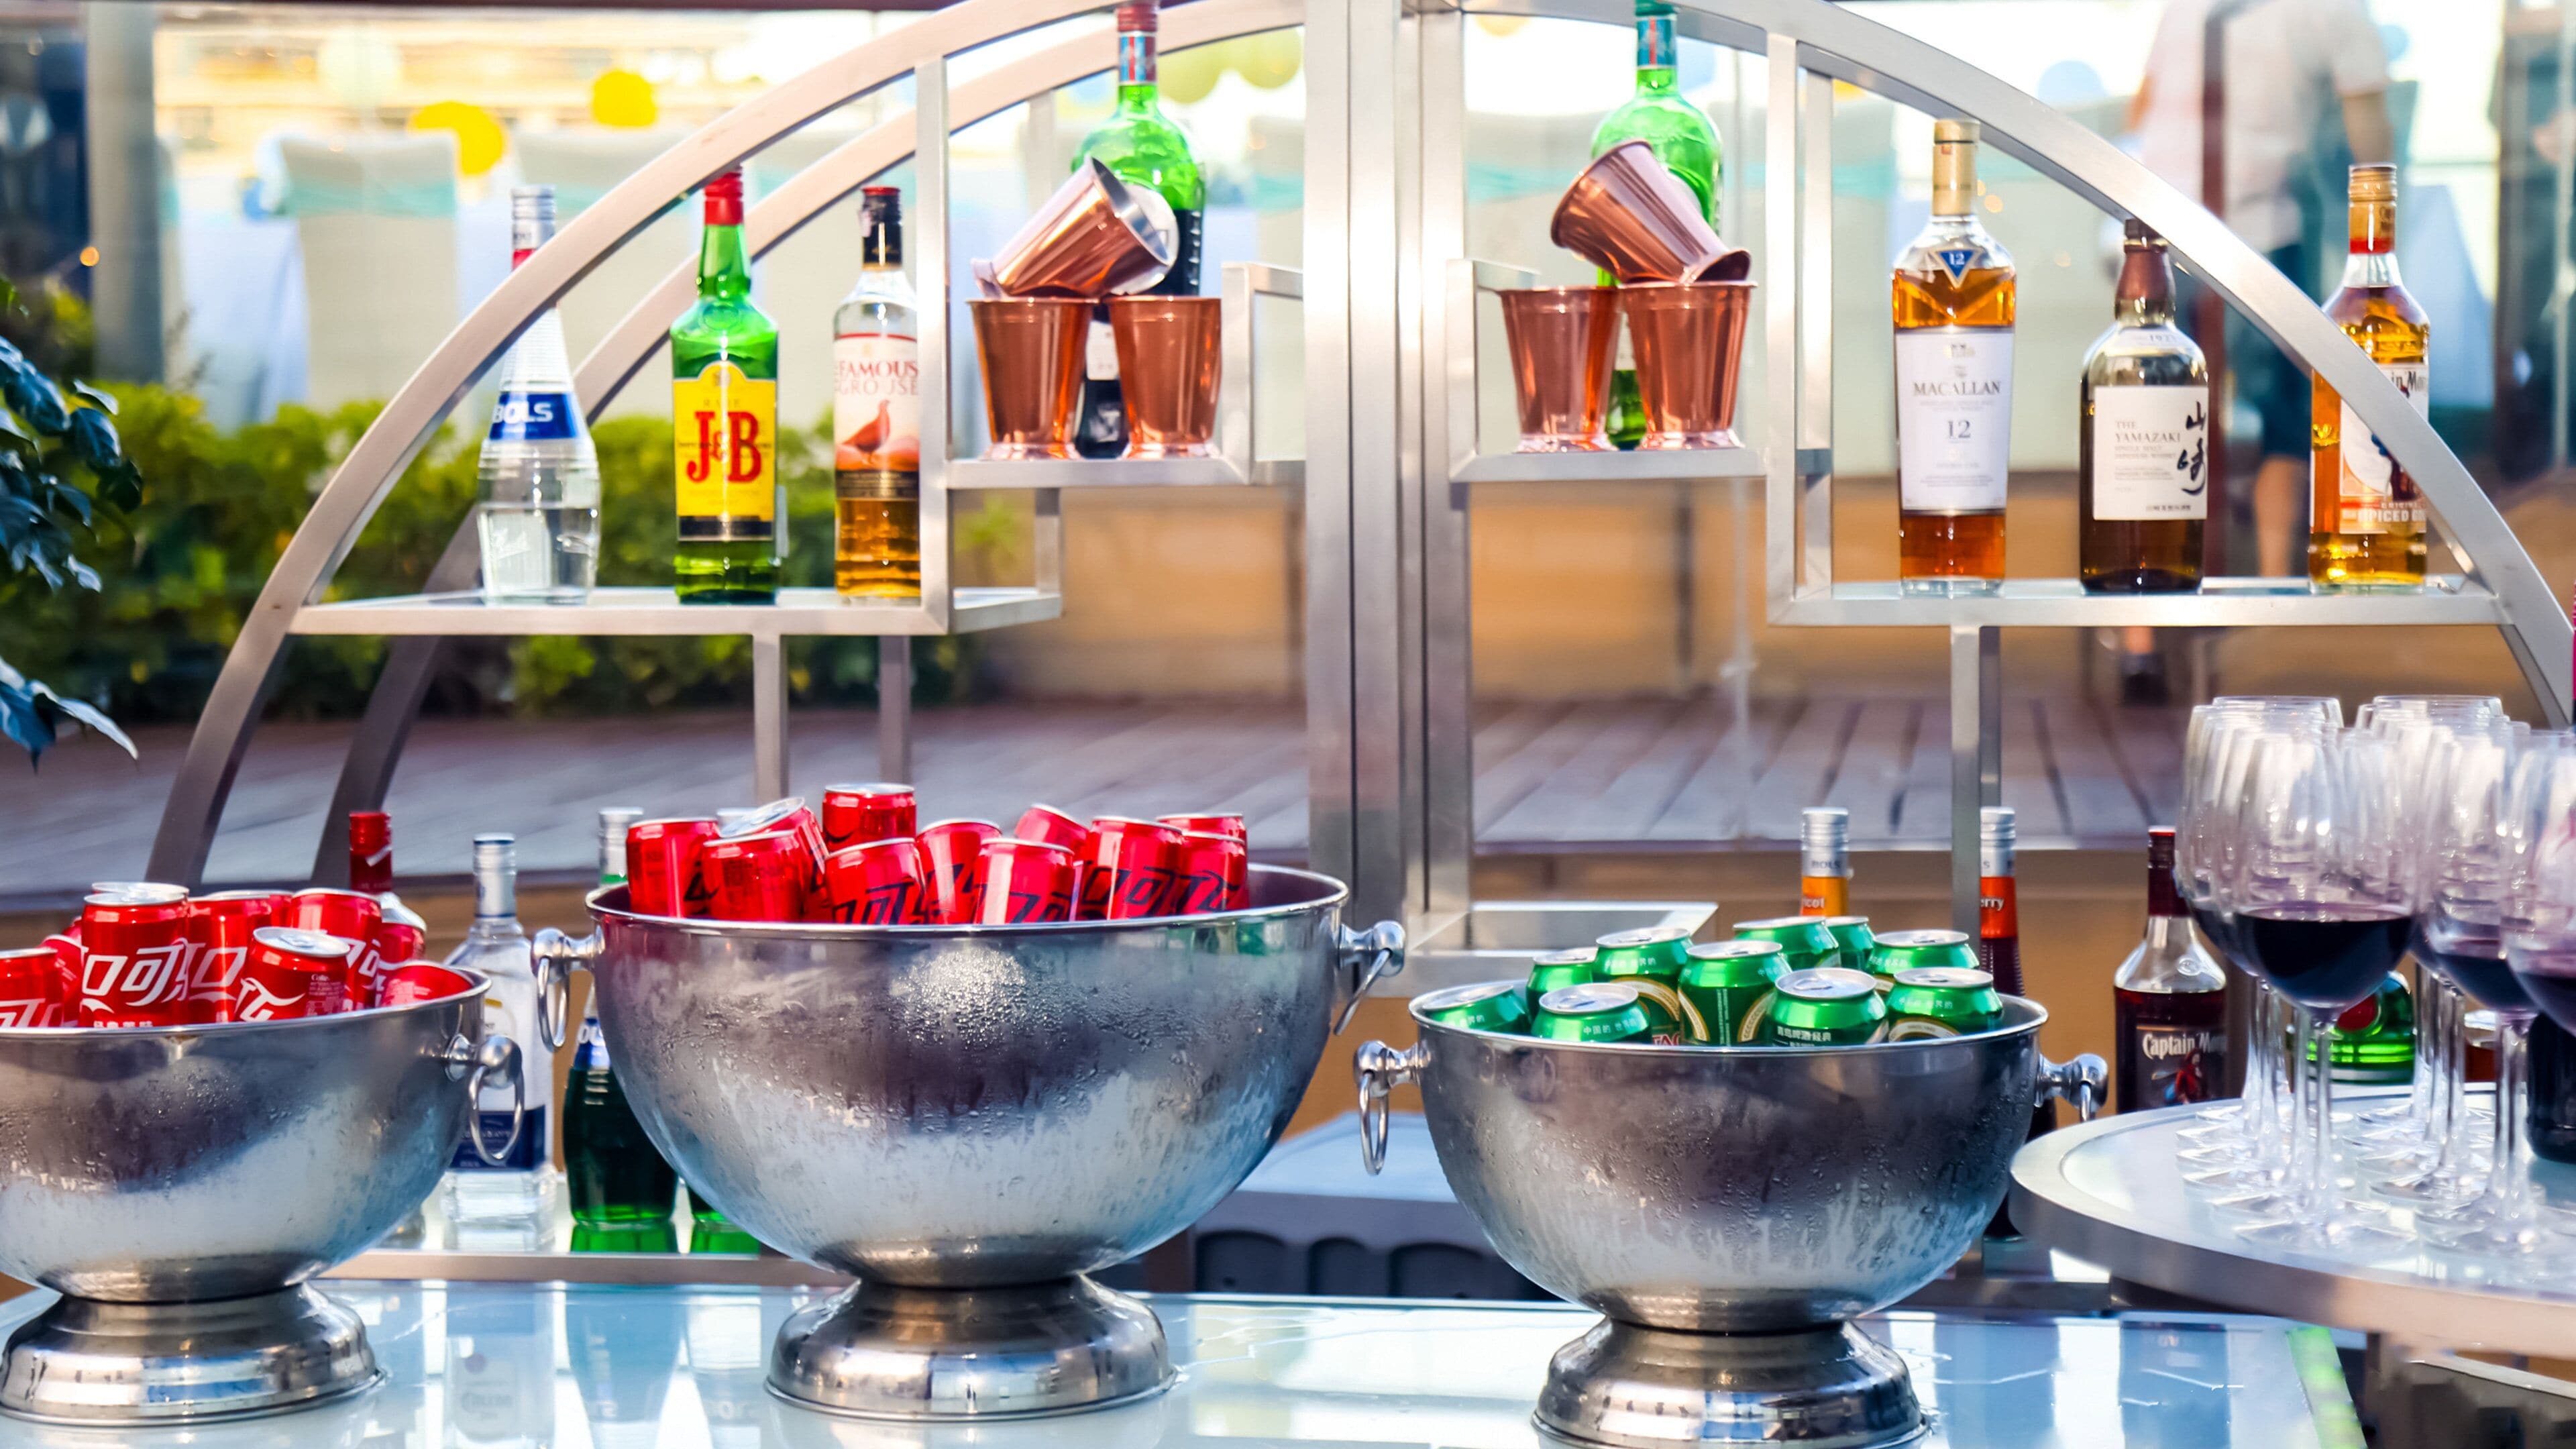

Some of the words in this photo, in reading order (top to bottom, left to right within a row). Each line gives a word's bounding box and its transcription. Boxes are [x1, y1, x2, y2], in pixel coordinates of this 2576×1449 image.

[1949, 253, 1965, 265] 12
[839, 360, 918, 378] FAMOUS
[1913, 381, 2002, 396] MACALLAN
[492, 401, 553, 424] BOLS
[1948, 421, 1971, 438] 12
[2115, 433, 2180, 443] YAMAZAKI
[686, 411, 761, 484] J&B
[1980, 898, 2004, 911] erry
[2143, 1034, 2195, 1059] Captain
